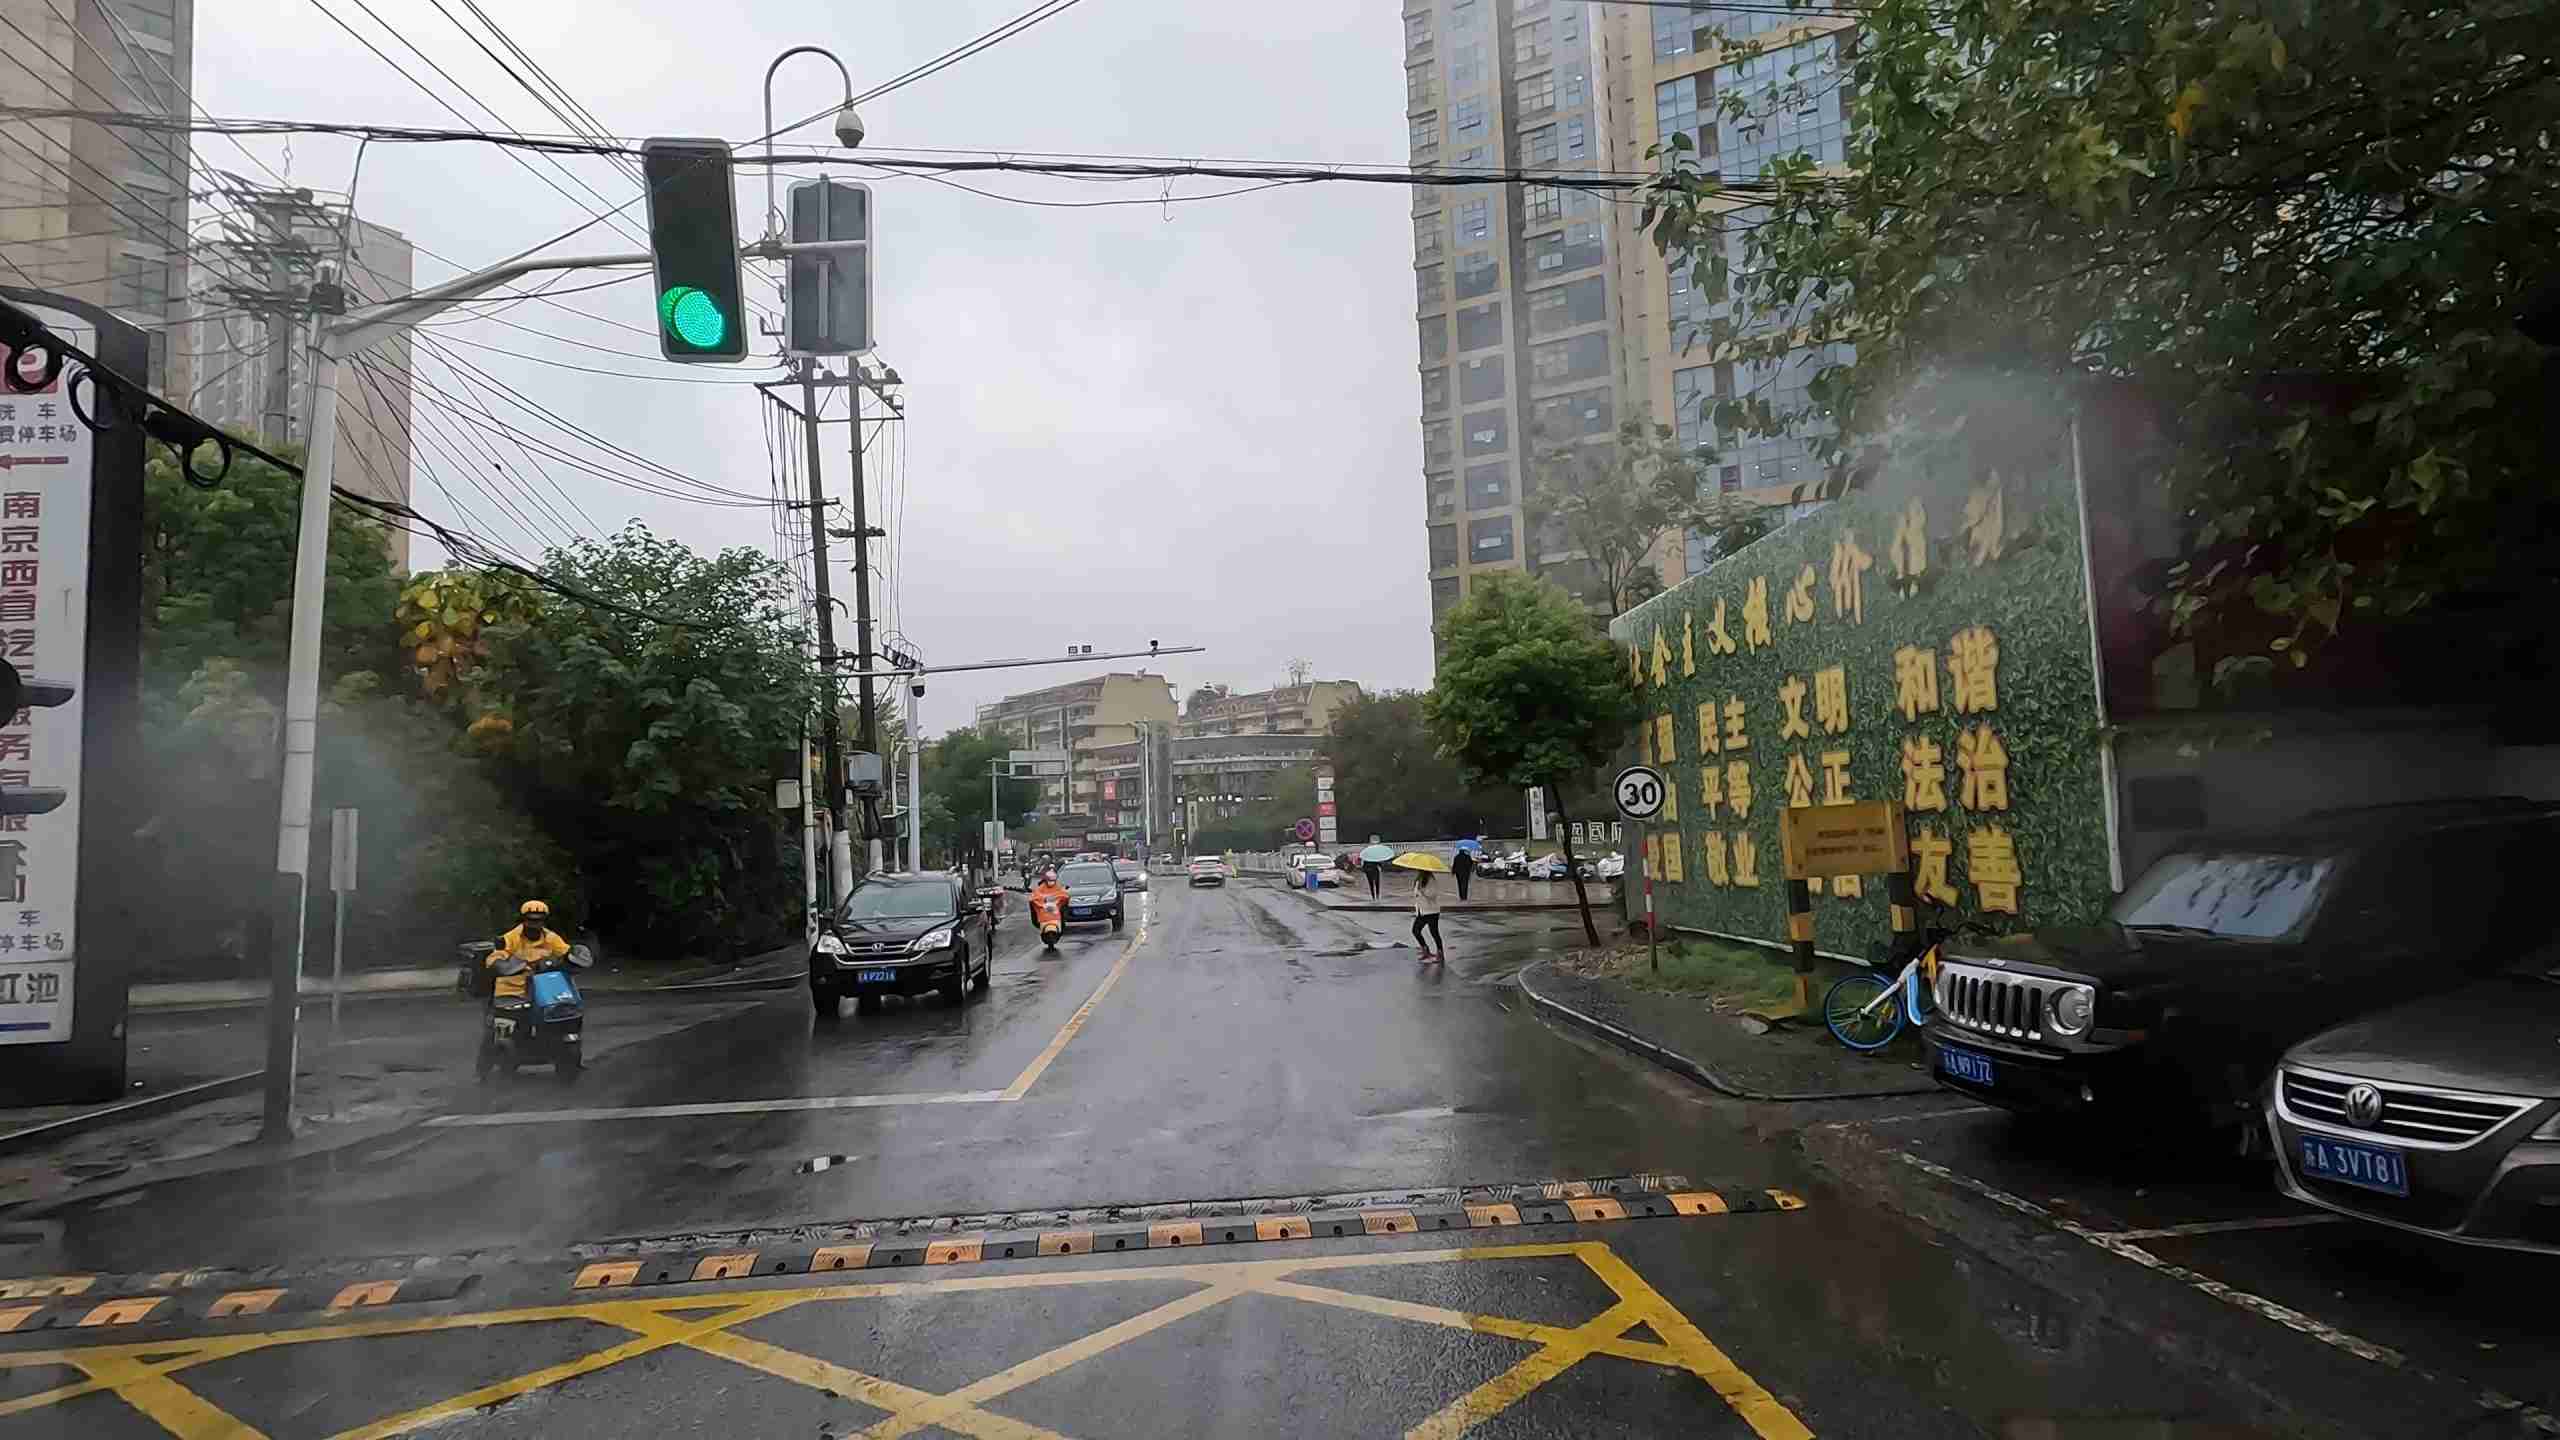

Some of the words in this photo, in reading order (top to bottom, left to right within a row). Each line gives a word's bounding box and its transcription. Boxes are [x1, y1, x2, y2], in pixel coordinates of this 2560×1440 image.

[1698, 695, 1749, 755] 民主
[1778, 663, 1850, 740] 文明
[1893, 624, 2000, 722] 和谐
[1623, 782, 1658, 807] 30
[1702, 760, 1753, 820] 平等
[1784, 750, 1855, 808] 公正
[1902, 724, 2009, 812] 法治
[1911, 825, 2023, 914] 友善
